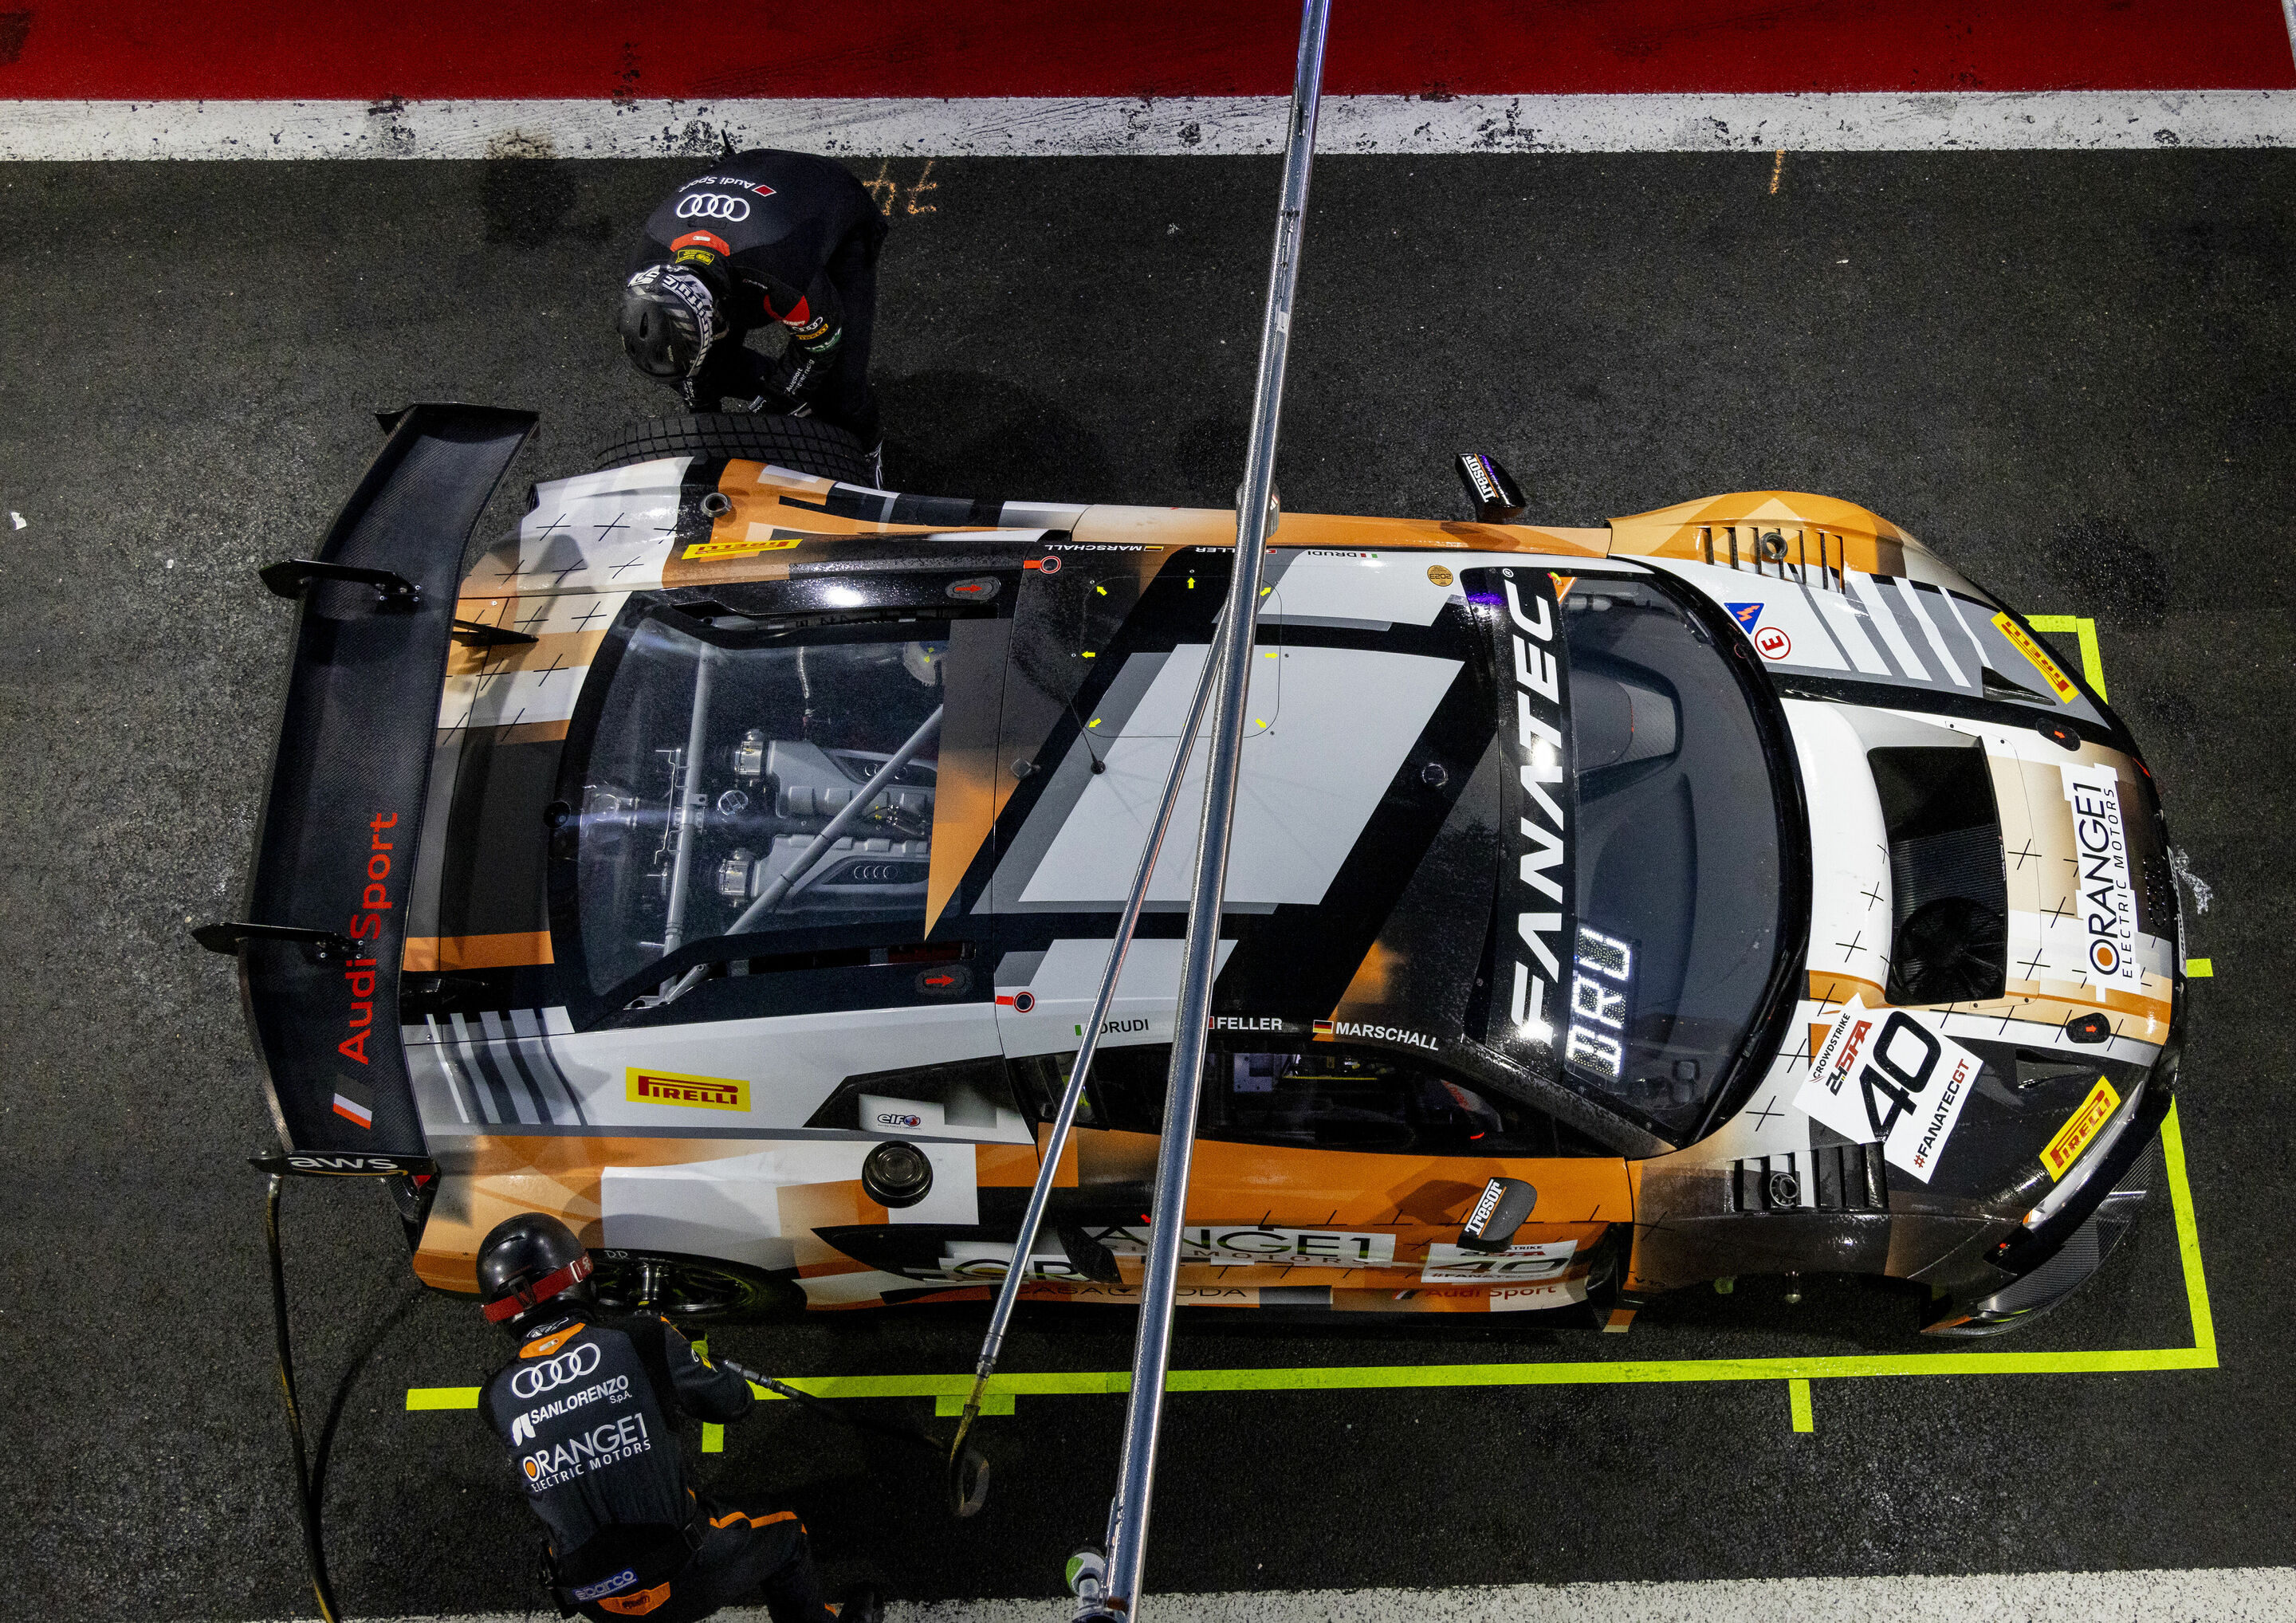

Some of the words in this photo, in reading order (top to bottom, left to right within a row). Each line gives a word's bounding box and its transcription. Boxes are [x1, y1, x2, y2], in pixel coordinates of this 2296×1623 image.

[678, 175, 718, 193] Sport
[720, 177, 756, 189] Audi
[1462, 456, 1496, 503] Tresor
[695, 541, 789, 555] PIRELLI
[1760, 635, 1785, 652] E
[2001, 621, 2070, 693] PIRELLI
[2103, 788, 2125, 870] MOTORS
[350, 812, 399, 940] Sport
[2073, 782, 2121, 976] ORANGE1
[2115, 879, 2133, 979] ELECTRIC
[338, 957, 377, 1066] Audi
[1217, 1016, 1283, 1031] FELLER
[1335, 1021, 1440, 1051] MARSCHALL
[1812, 1012, 1850, 1079] CROWDSTRIKE
[638, 1075, 739, 1105] PIRELLI
[1859, 1011, 1942, 1142] 40
[1913, 1058, 1970, 1169] #FANATECGT
[2050, 1090, 2112, 1169] PIRELLI
[287, 1157, 399, 1170] aws
[1464, 1178, 1501, 1238] Tresor
[1429, 1257, 1570, 1275] 40
[1175, 1288, 1247, 1298] ODA
[1425, 1287, 1480, 1298] Audi
[1489, 1286, 1557, 1300] Sport
[530, 1373, 630, 1425] SANLORENZO
[521, 1412, 649, 1483] ORANGE1
[532, 1465, 585, 1493] ELECTRIC
[589, 1439, 652, 1469] MOTORS
[574, 1570, 637, 1601] sparco
